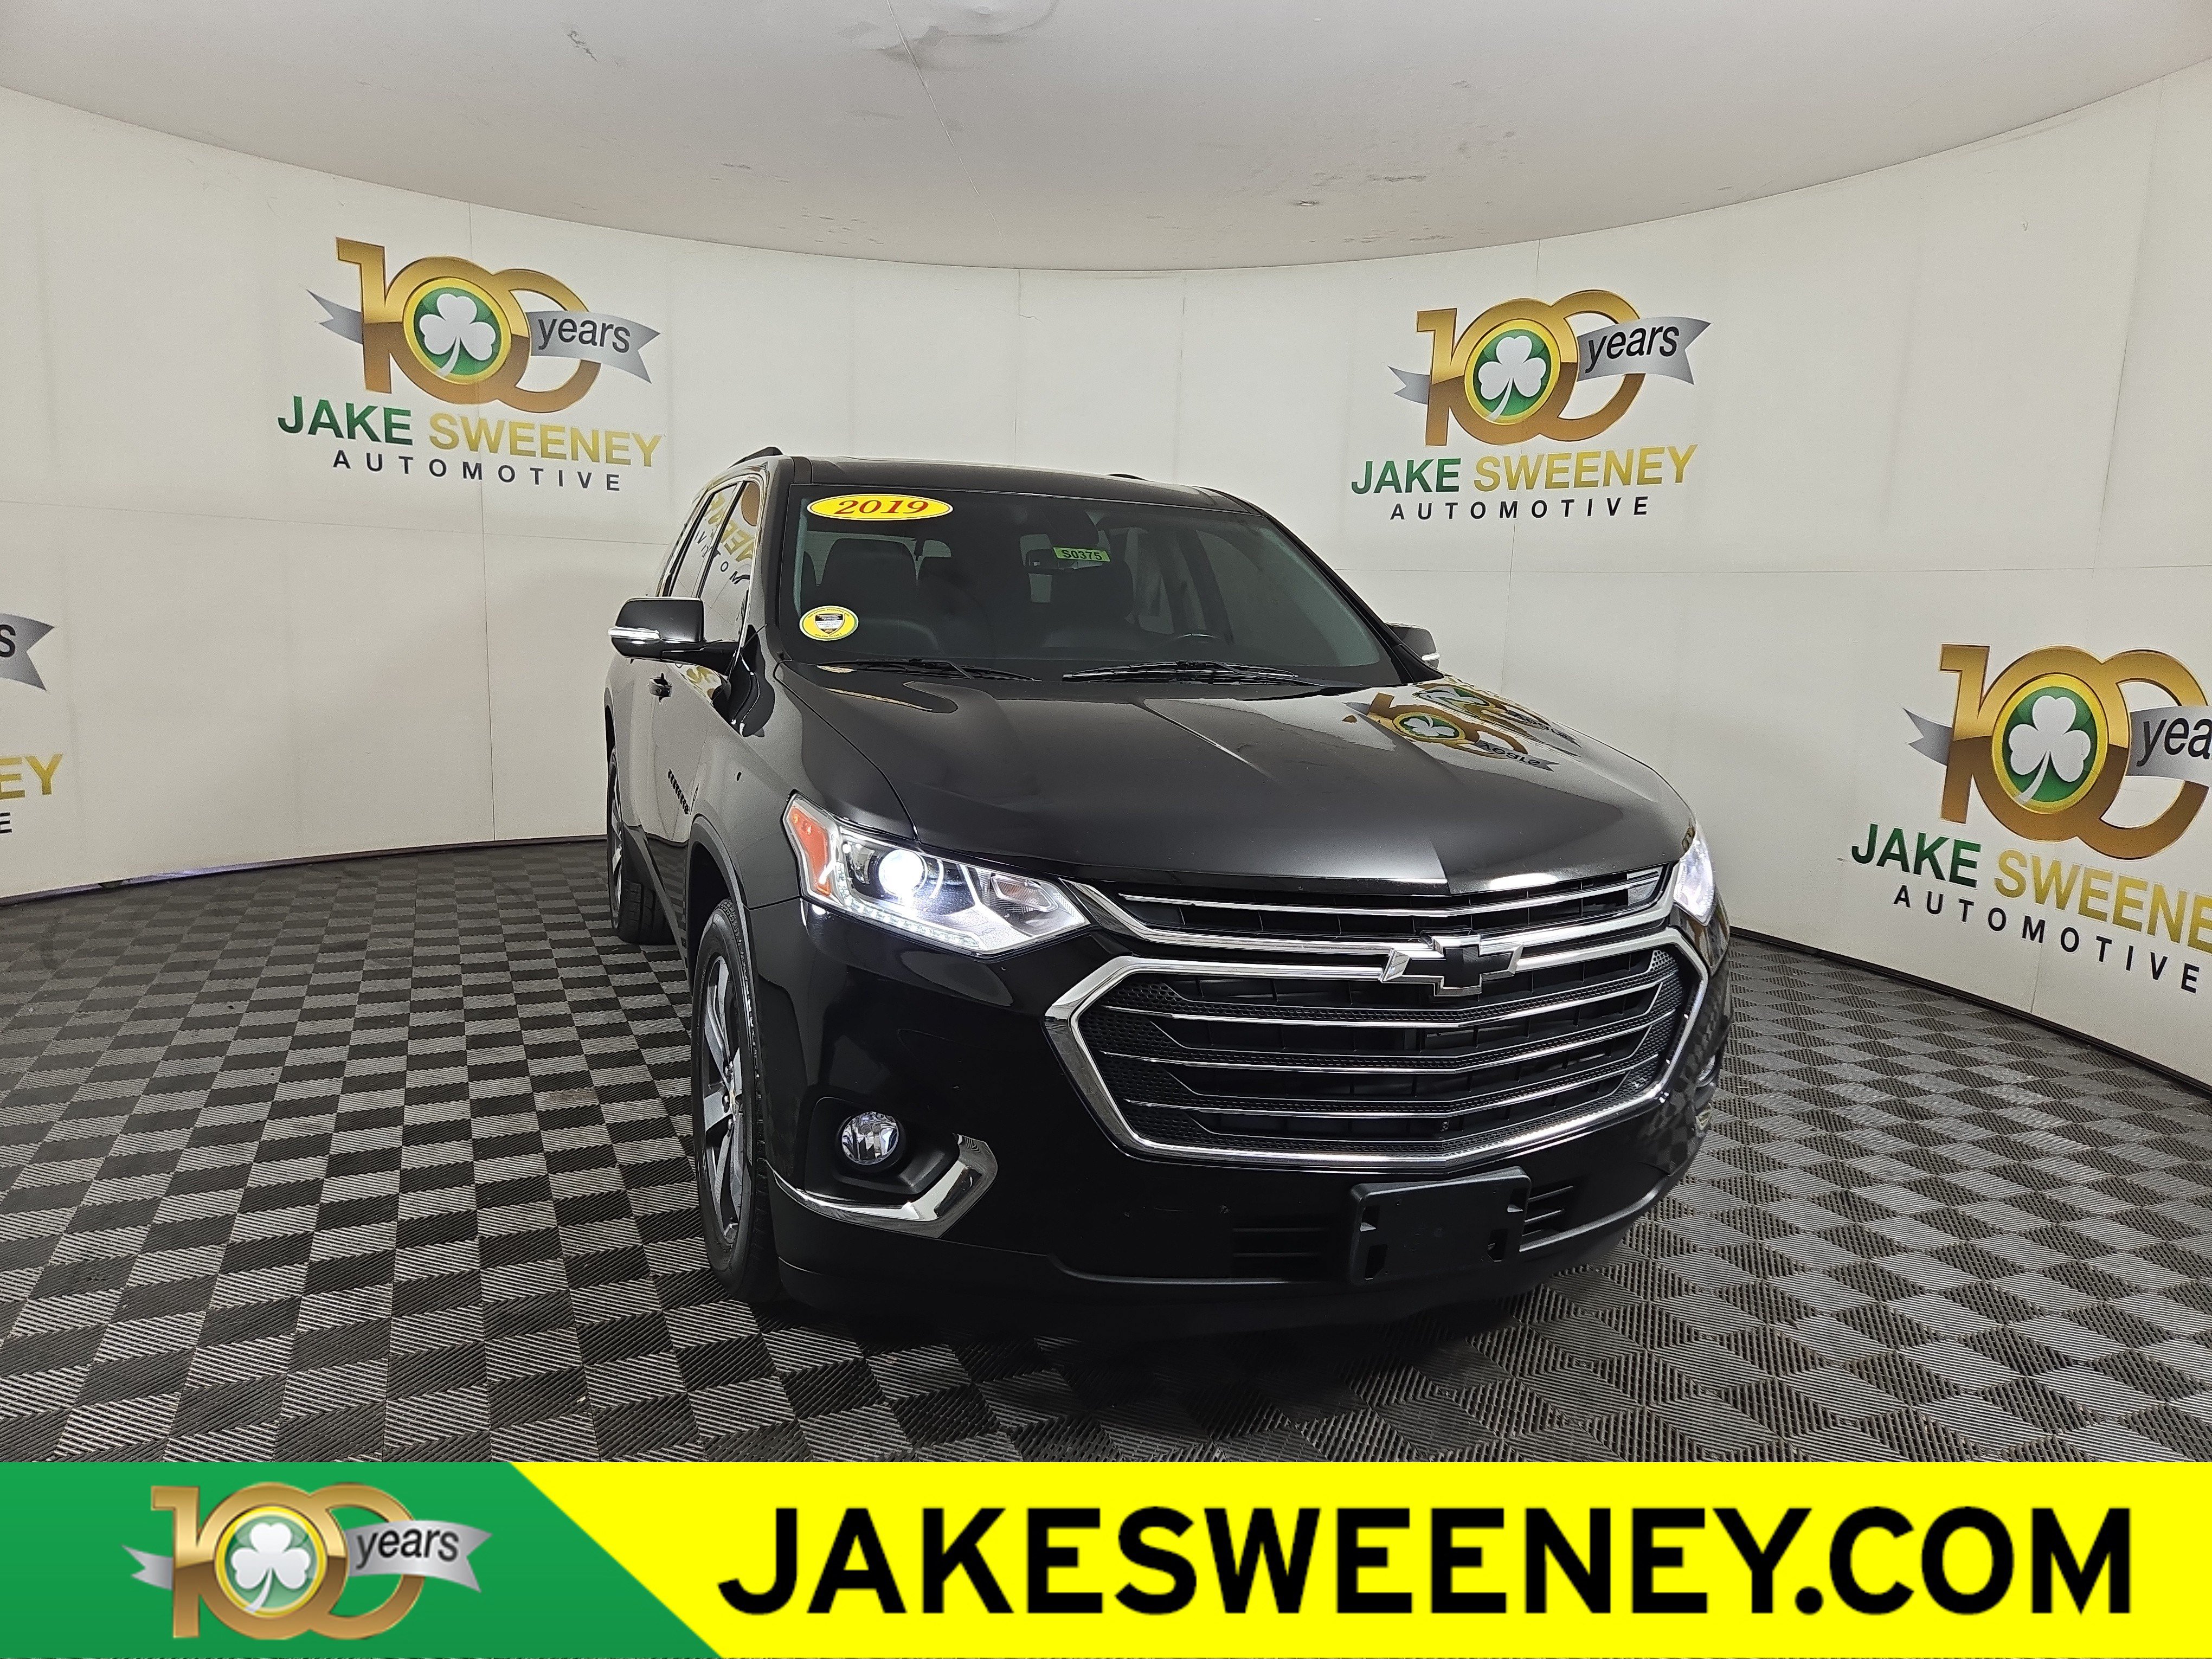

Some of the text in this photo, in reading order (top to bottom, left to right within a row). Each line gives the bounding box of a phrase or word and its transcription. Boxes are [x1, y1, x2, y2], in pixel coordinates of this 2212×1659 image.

[336, 237, 631, 413] 100 years
[1416, 290, 1680, 446] 100 years
[278, 395, 663, 468] JAKE SWEENEY
[332, 449, 621, 491] AUTOMOTIVE
[1351, 444, 1698, 494] JAKE SWEENEY
[834, 499, 930, 515] 2019
[1390, 496, 1649, 520] AUTOMOTIVE
[1061, 549, 1103, 561] S0375
[1939, 644, 2212, 860] 100 yea
[1851, 823, 2212, 954] JAKE SWEENE
[1893, 884, 2200, 993] AUTOMOTIVE
